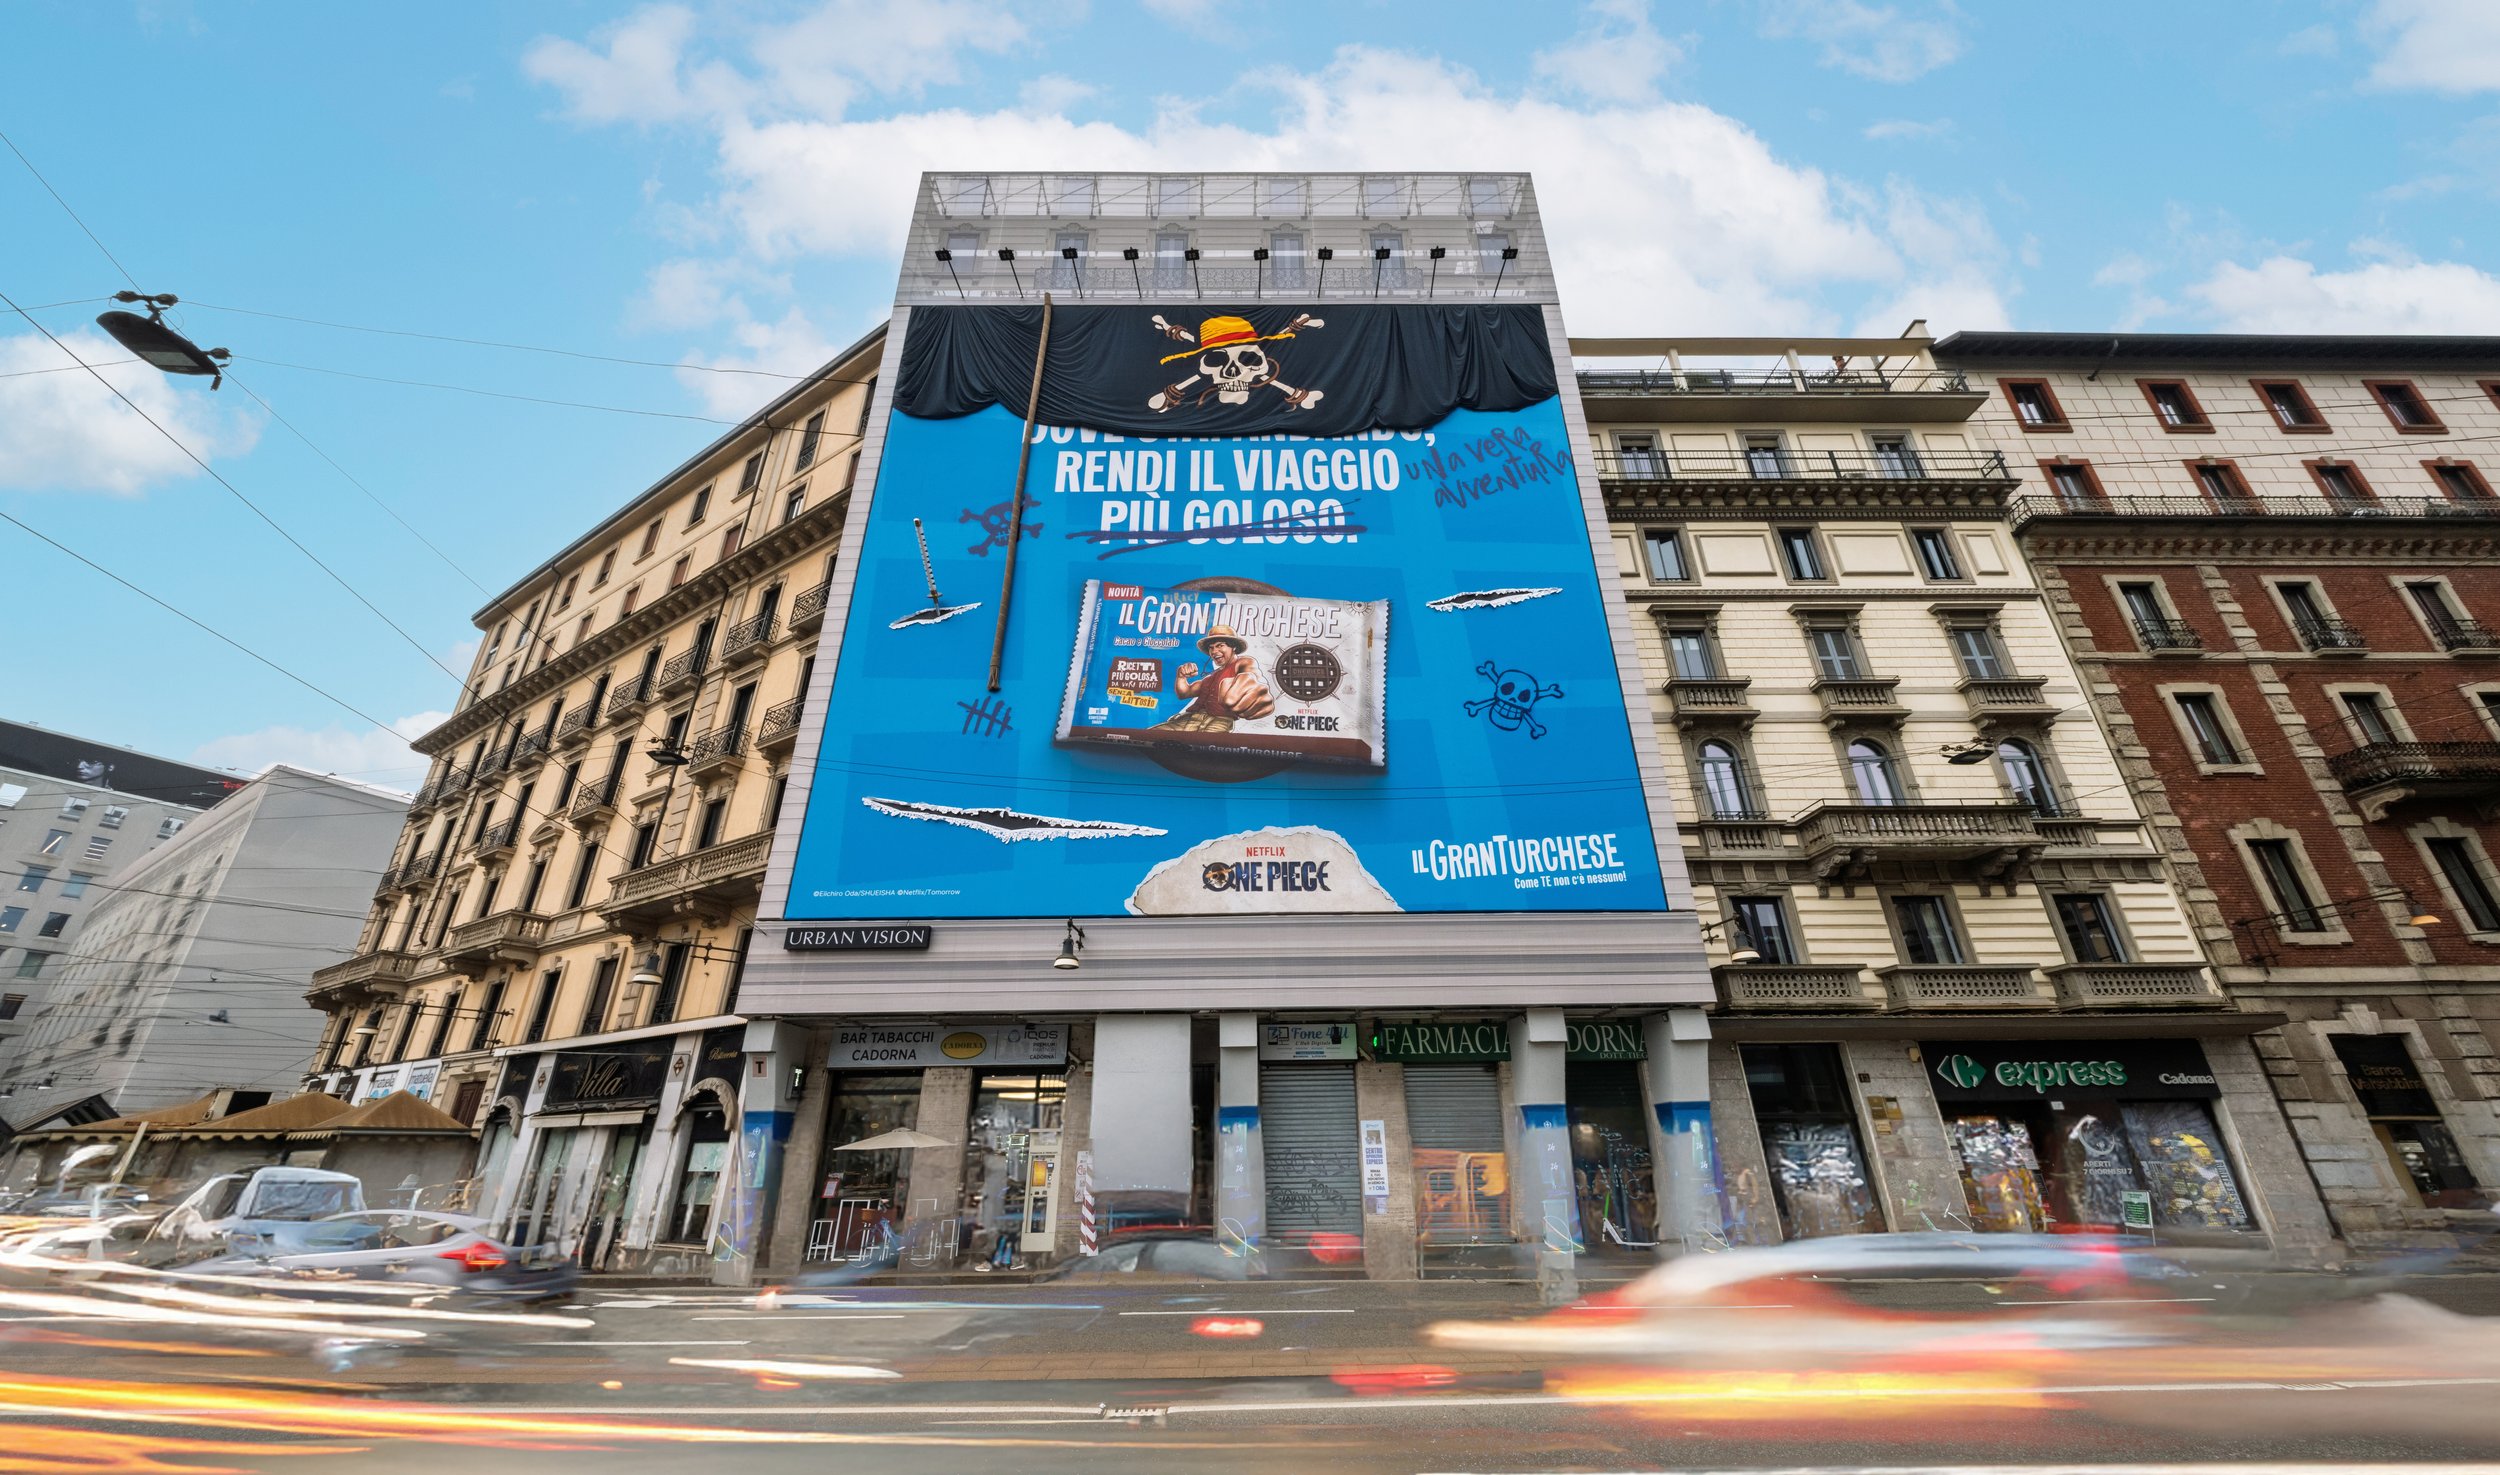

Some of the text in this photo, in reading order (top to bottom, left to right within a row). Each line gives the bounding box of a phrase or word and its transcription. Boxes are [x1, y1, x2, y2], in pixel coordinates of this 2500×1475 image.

[1054, 448, 1400, 493] RENDI IL VIAGGIO
[1099, 491, 1170, 545] PIÙ
[1107, 586, 1140, 598] NOVITÀ
[1118, 603, 1136, 625] IL
[1117, 661, 1155, 671] RICETTA
[1125, 672, 1158, 682] GOLOSA
[1108, 688, 1132, 697] SENZA
[1275, 714, 1339, 732] ONE PIECE
[1246, 846, 1286, 858] NETFLIX
[1412, 850, 1429, 874] IL
[1202, 861, 1332, 892] ONE PIECE
[1514, 877, 1539, 890] Come
[1540, 876, 1551, 887] TE
[1553, 875, 1570, 887] non
[1587, 870, 1627, 884] nessuno!
[789, 929, 925, 945] URBAN VISION
[840, 1031, 934, 1044] BAR TABACCHI
[1291, 1027, 1323, 1039] Fone
[851, 1049, 917, 1061] CADORNA
[755, 1061, 764, 1074] T
[2360, 1065, 2404, 1076] Banca
[576, 1055, 625, 1099] Villa
[1995, 1060, 2216, 1094] express Cadorna
